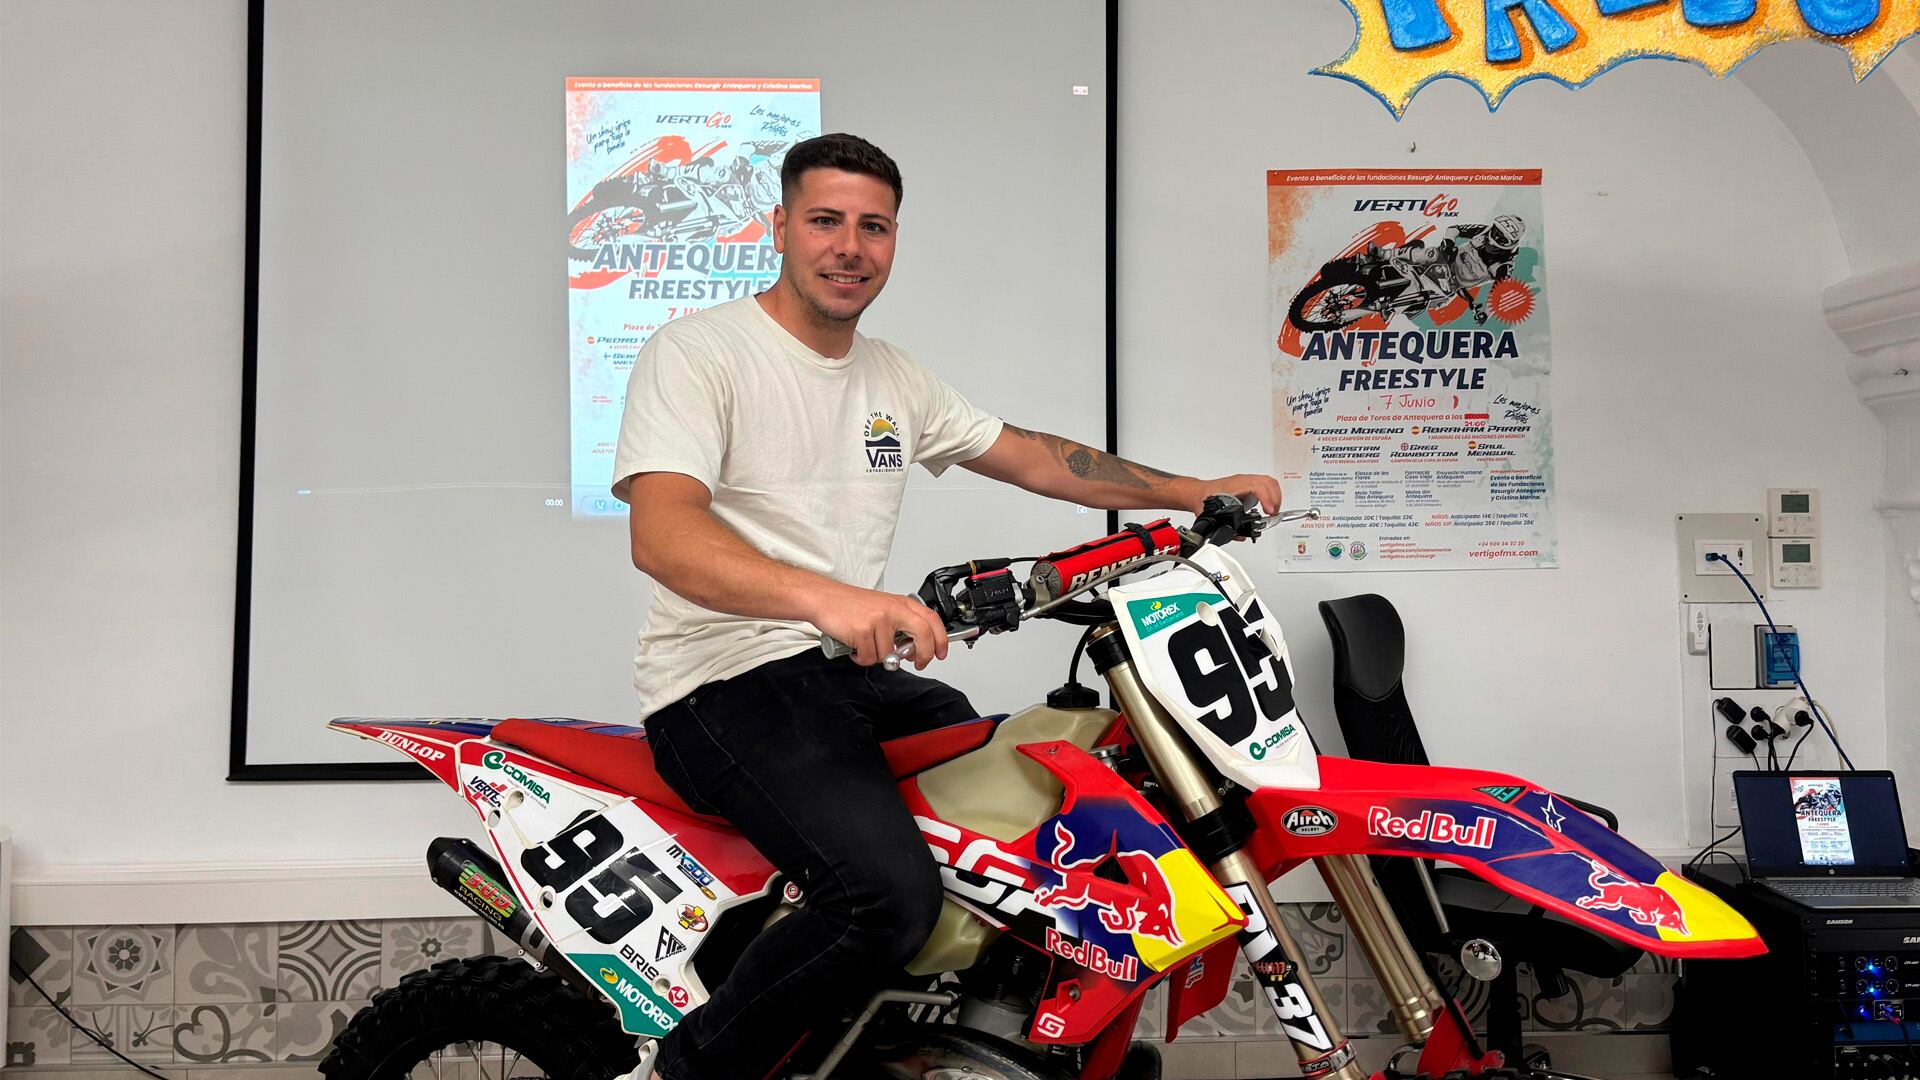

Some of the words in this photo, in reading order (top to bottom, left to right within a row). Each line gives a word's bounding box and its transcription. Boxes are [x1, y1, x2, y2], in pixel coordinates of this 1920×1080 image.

[1407, 174, 1433, 182] Resurgir
[1434, 174, 1468, 182] Antequera
[593, 244, 778, 277] ANTEQUER
[629, 279, 771, 300] FREESTYLE
[667, 308, 677, 320] 7
[1301, 331, 1519, 364] ANTEQUERA
[1338, 368, 1487, 391] FREESTYLE
[1380, 394, 1392, 410] 7
[864, 419, 872, 437] OFF
[870, 411, 882, 419] THE
[1403, 414, 1444, 422] Antequera
[1304, 427, 1348, 435] PEDRO
[866, 449, 903, 468] VANS
[1469, 549, 1538, 559] vertigofmx.com
[1141, 602, 1180, 627] MOTOREX
[1168, 598, 1293, 746] 95
[377, 731, 446, 762] DUNLOP
[1265, 724, 1296, 748] COMISA
[503, 764, 551, 804] COMISA
[1286, 810, 1334, 829] Airoh
[1367, 805, 1433, 842] Red
[1430, 812, 1497, 849] Bull
[521, 810, 684, 945] 95
[460, 885, 502, 920] RACING
[619, 944, 660, 982] BRIS
[1046, 926, 1090, 967] Red
[1090, 945, 1138, 982] Bull
[616, 977, 678, 1032] MOTOREX
